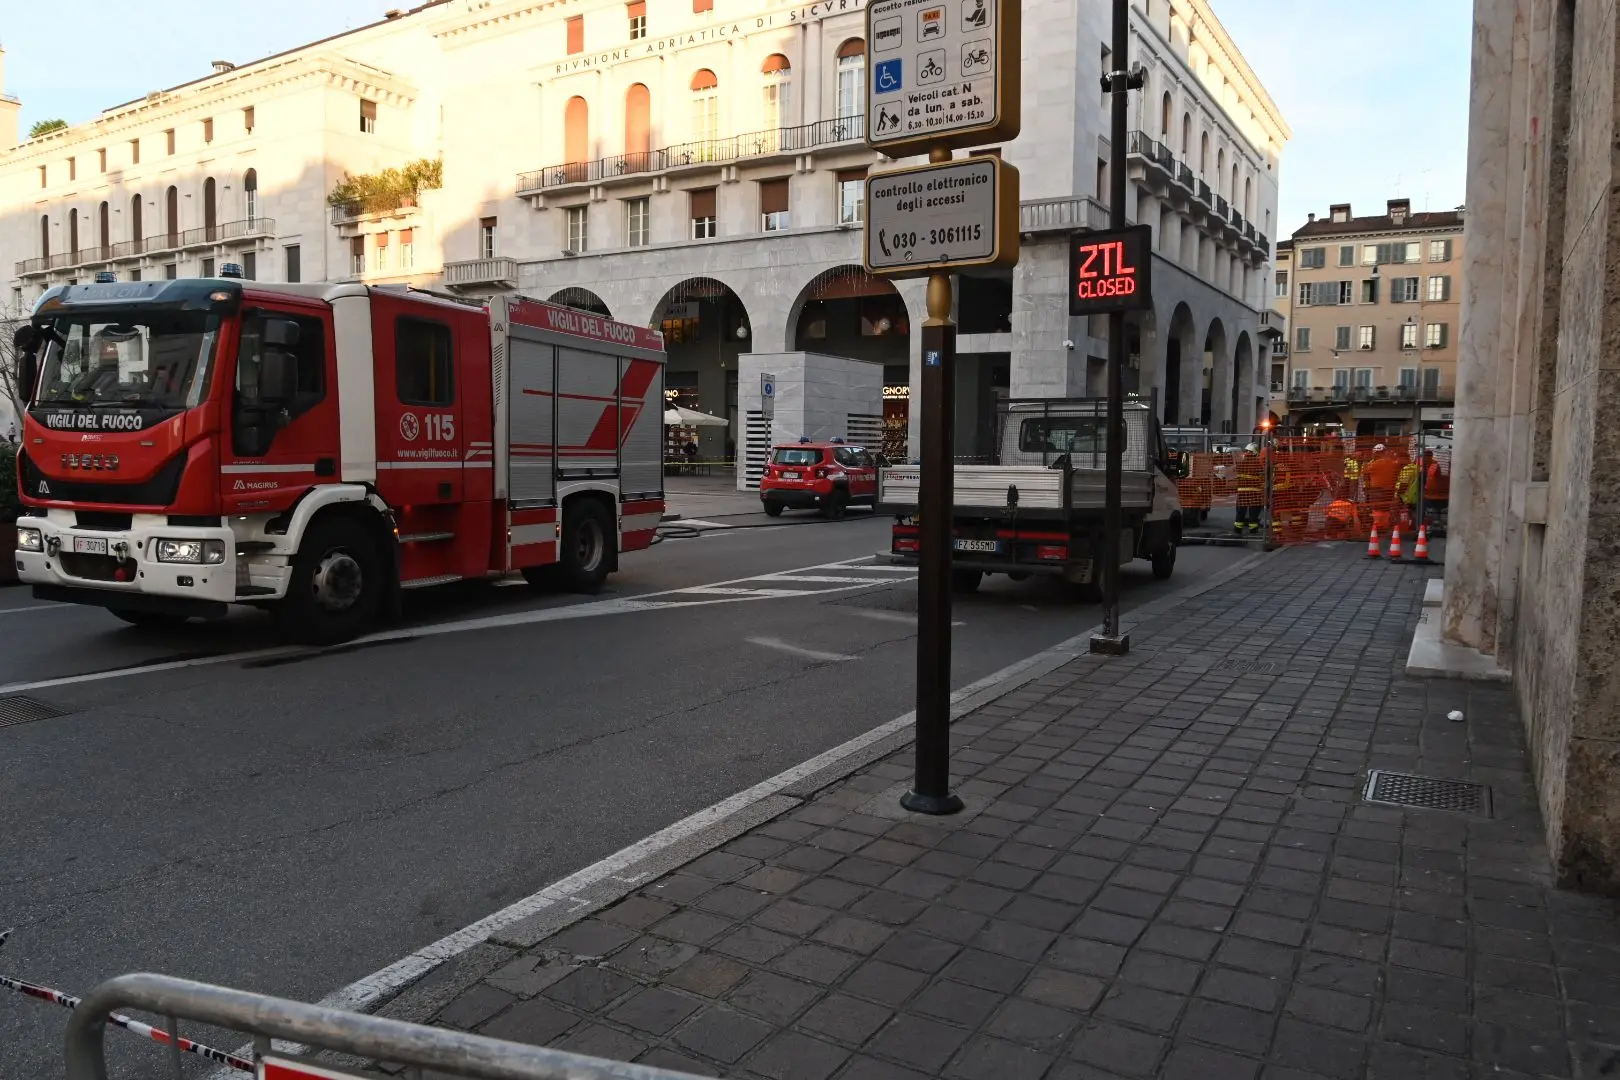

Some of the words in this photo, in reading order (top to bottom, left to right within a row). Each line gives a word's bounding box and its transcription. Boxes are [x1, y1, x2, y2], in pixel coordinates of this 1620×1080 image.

[874, 2, 902, 14] eccetto
[923, 10, 940, 21] TAXI
[556, 48, 629, 74] RIVNIONE
[646, 24, 740, 53] ADRIATICA
[756, 16, 772, 28] DI
[908, 90, 938, 104] Veicoli
[941, 86, 959, 98] cat.
[962, 83, 972, 94] N
[908, 106, 920, 117] da
[925, 103, 945, 114] lun.
[961, 96, 983, 107] sab.
[875, 181, 923, 199] controllo
[926, 172, 988, 192] elettronico
[896, 197, 923, 212] degli
[926, 191, 965, 208] accessi
[892, 231, 916, 249] 030
[930, 224, 981, 245] 3061115
[1080, 241, 1135, 278] ZTL
[1078, 277, 1135, 298] CLOSED
[547, 310, 580, 332] VIGILI
[581, 317, 601, 336] DEL
[604, 322, 636, 344] FUOCO
[46, 414, 75, 428] VIGILI
[77, 414, 99, 429] DEL
[102, 415, 143, 430] FUOCO
[424, 413, 455, 441] 115
[61, 453, 119, 471] IVECO
[397, 447, 458, 460] www.vigilfuoco.it
[247, 481, 278, 489] MAGIRUS
